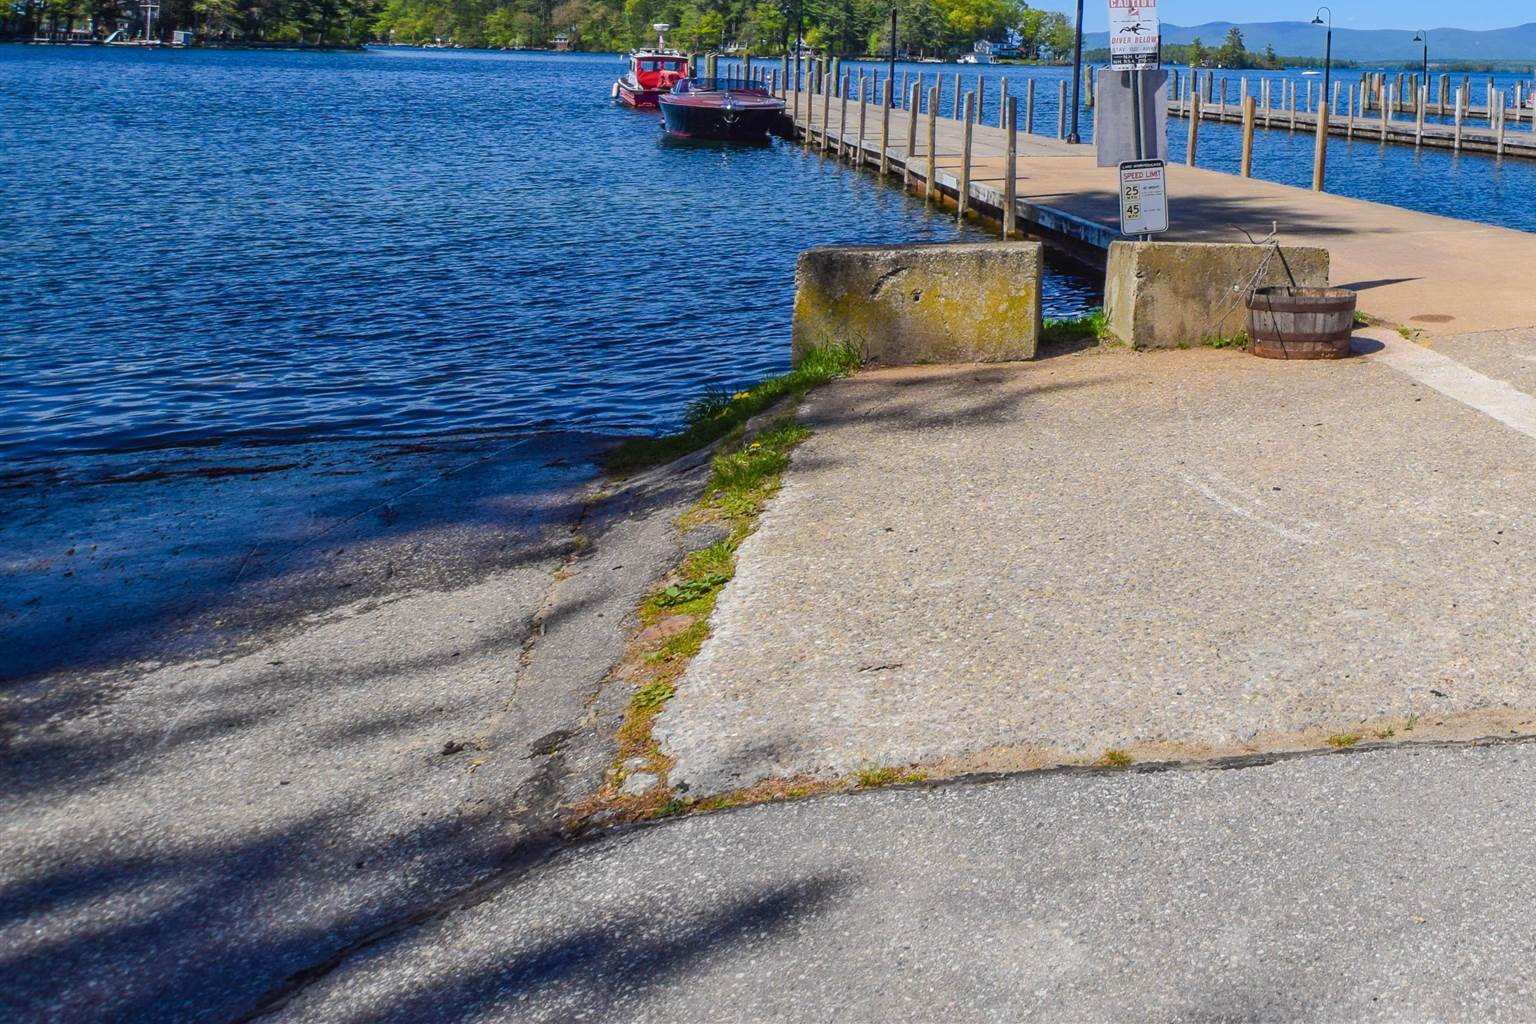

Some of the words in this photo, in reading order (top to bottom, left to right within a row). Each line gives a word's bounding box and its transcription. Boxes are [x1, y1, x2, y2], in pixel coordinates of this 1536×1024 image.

[1112, 37, 1132, 45] DIVER
[1135, 35, 1158, 44] BELOW
[1146, 170, 1161, 178] LIMIT
[1125, 186, 1139, 195] 25
[1127, 205, 1139, 214] 45
